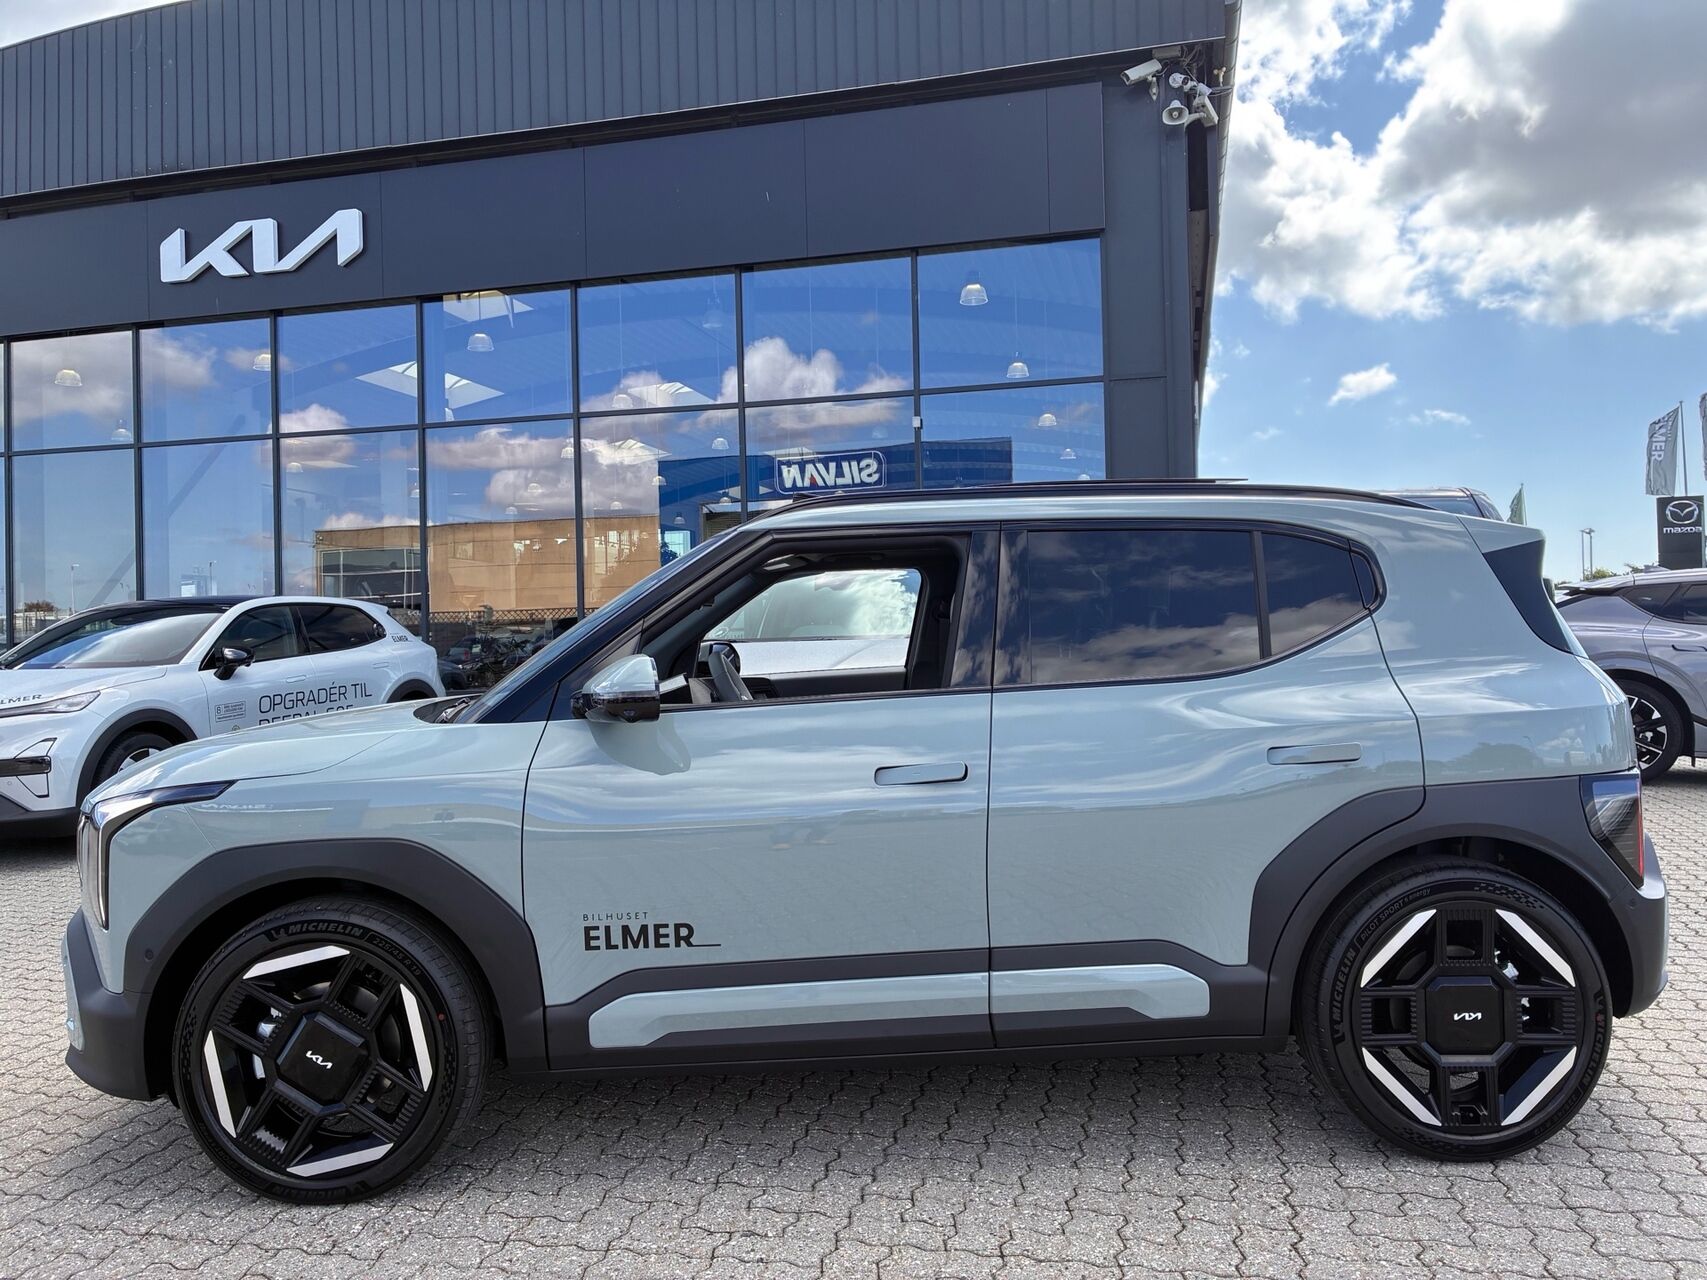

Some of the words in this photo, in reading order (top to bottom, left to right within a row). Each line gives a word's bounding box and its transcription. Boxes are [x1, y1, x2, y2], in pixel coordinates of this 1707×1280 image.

[160, 208, 363, 283] KIA
[1663, 526, 1702, 534] mazda
[0, 694, 42, 704] LMER
[258, 682, 348, 714] OPGRADÉR
[351, 682, 372, 699] TIL
[582, 911, 649, 921] BILHUSET
[288, 922, 364, 938] MICHELIN
[584, 922, 721, 951] ELMER
[1332, 947, 1356, 1022] MICHELIN
[1453, 1011, 1482, 1021] KIA
[305, 1050, 333, 1069] KIA
